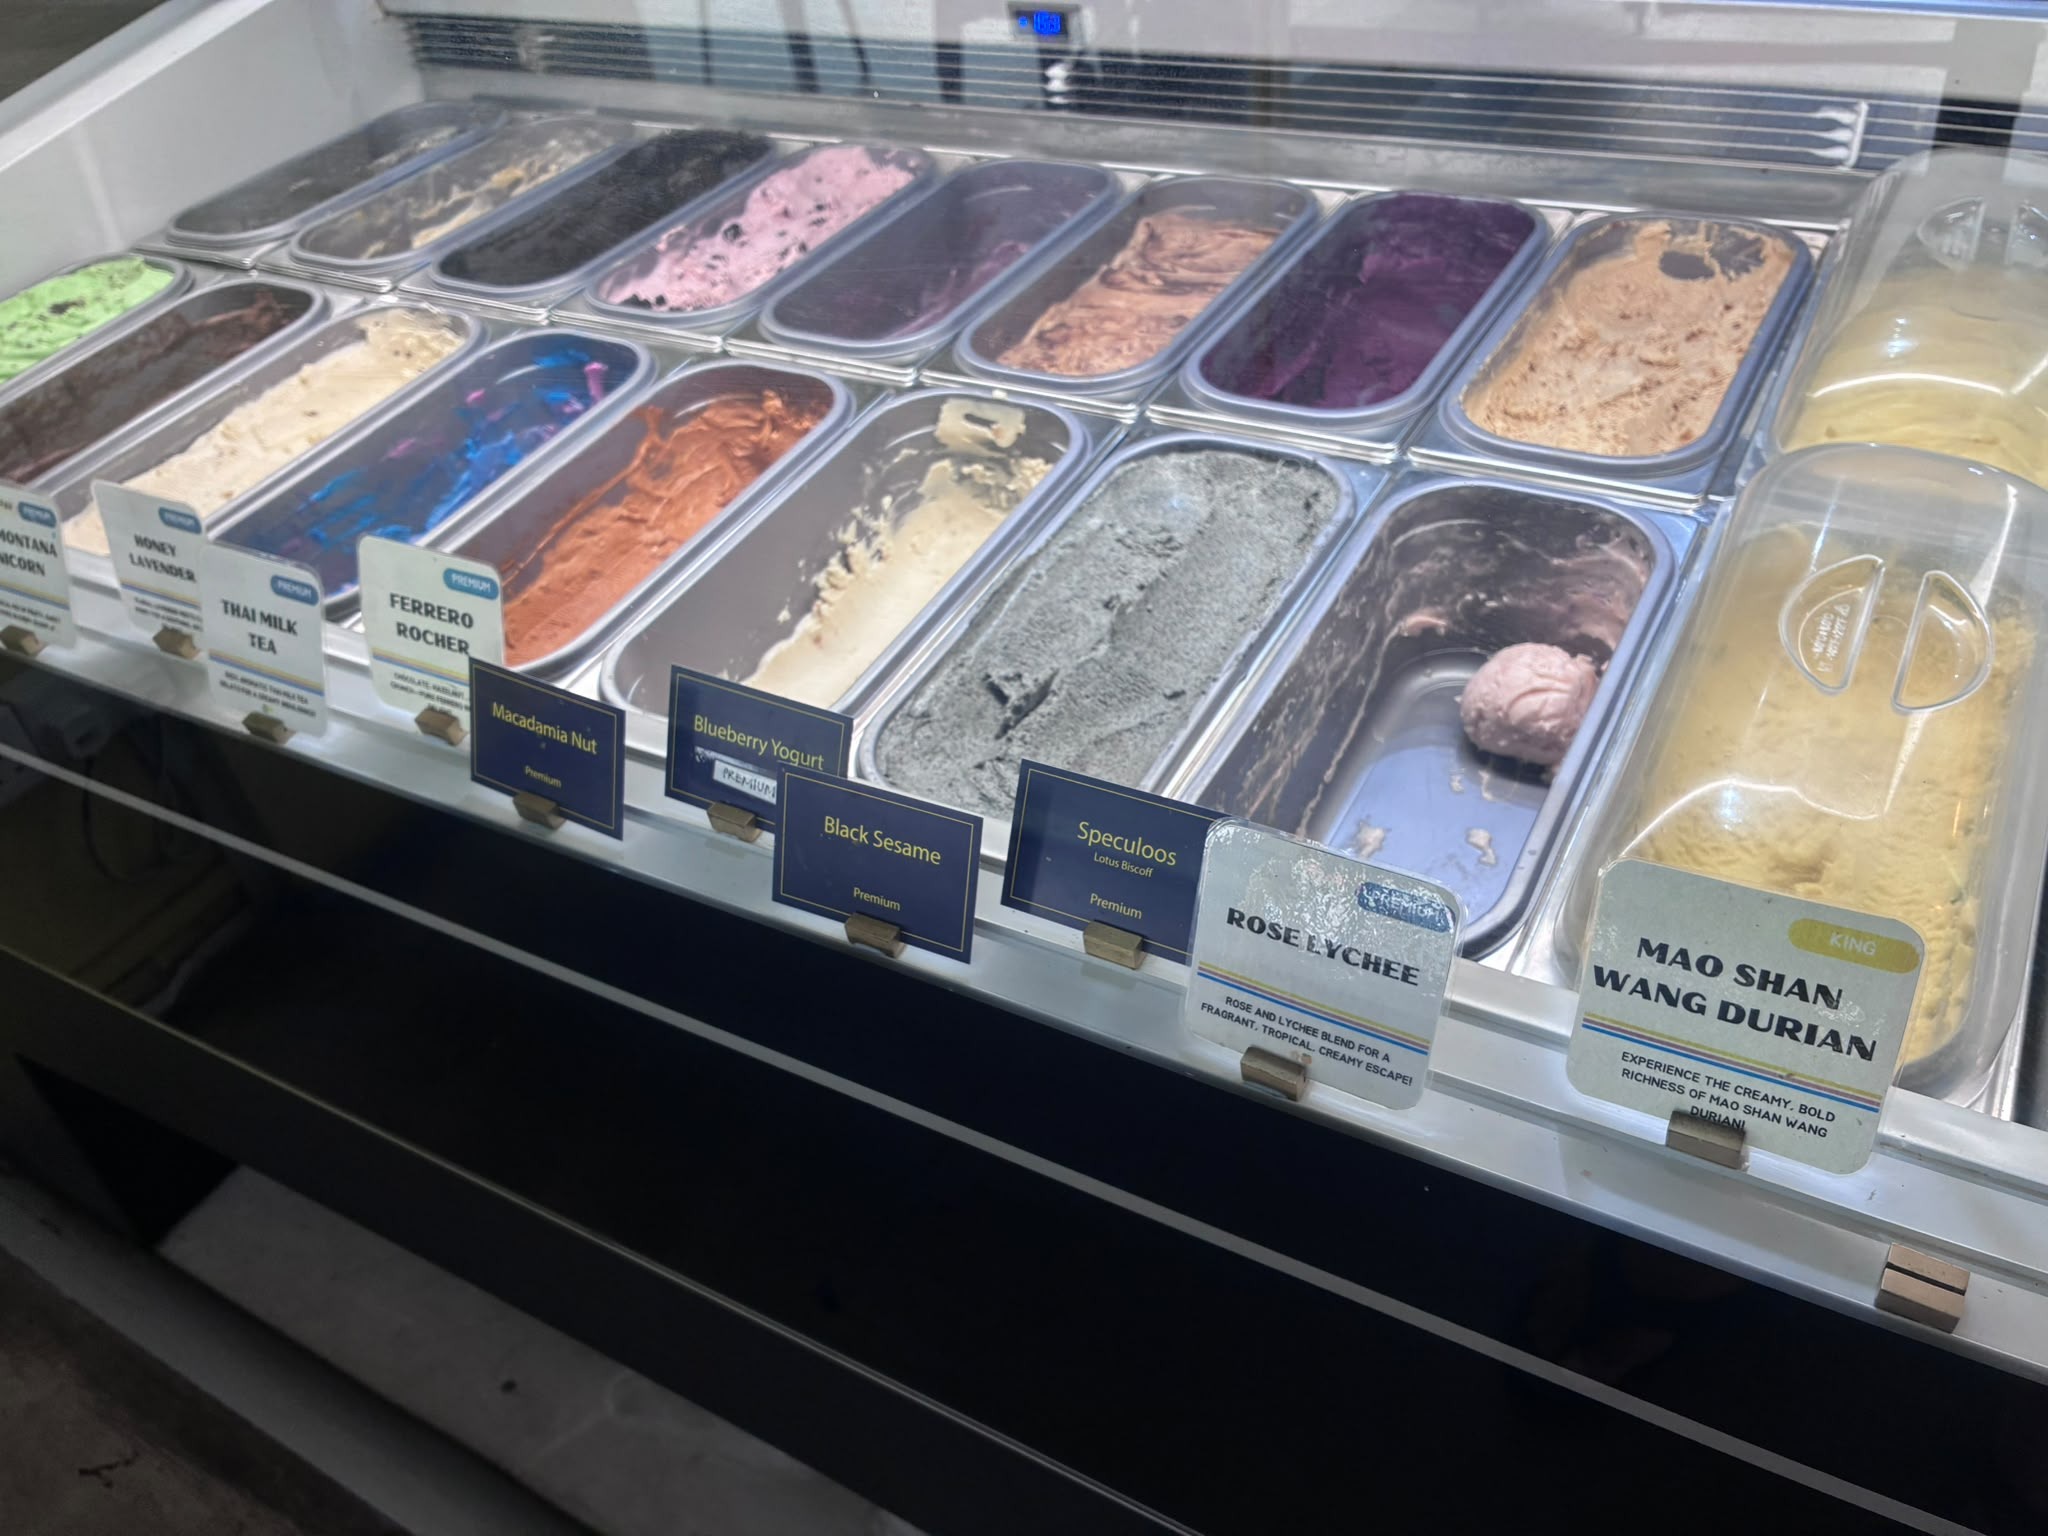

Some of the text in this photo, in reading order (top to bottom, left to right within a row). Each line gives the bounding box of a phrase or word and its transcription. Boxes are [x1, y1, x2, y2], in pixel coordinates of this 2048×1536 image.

[133, 533, 177, 557] HONEY
[128, 551, 197, 583] LAVENDER
[451, 573, 491, 593] PREMIUM
[221, 598, 257, 623] THAI
[259, 611, 298, 637] MILK
[389, 592, 473, 629] FERRERO
[247, 631, 277, 655] TEA
[396, 621, 470, 656] ROCHER
[492, 702, 598, 755] Macadamia Nut
[694, 715, 825, 771] Blueberry Yogurt
[525, 765, 562, 788] Premium
[824, 815, 942, 866] Black Sesame
[1077, 821, 1177, 866] Speculoos
[1093, 852, 1154, 878] Lotus Biscoff
[852, 886, 901, 912] Premium
[1090, 892, 1142, 920] Premium
[1226, 907, 1420, 986] ROSE LYCHEE
[1829, 932, 1877, 956] KING
[1637, 937, 1843, 1011] MAO SHAN
[1225, 996, 1391, 1063] ROSE AND LYCHEE BLEND FOR A
[1593, 965, 1877, 1062] WANG DURIAN
[1201, 1002, 1258, 1031] FRAGRANT,
[1319, 1046, 1364, 1068] CREAMY
[1365, 1062, 1413, 1087] ESCAPE!
[1621, 1051, 1835, 1122] EXPERIENCE THE CREAMY, BOLD
[1621, 1068, 1828, 1138] RICHNESS OF MAO SHAN WANG
